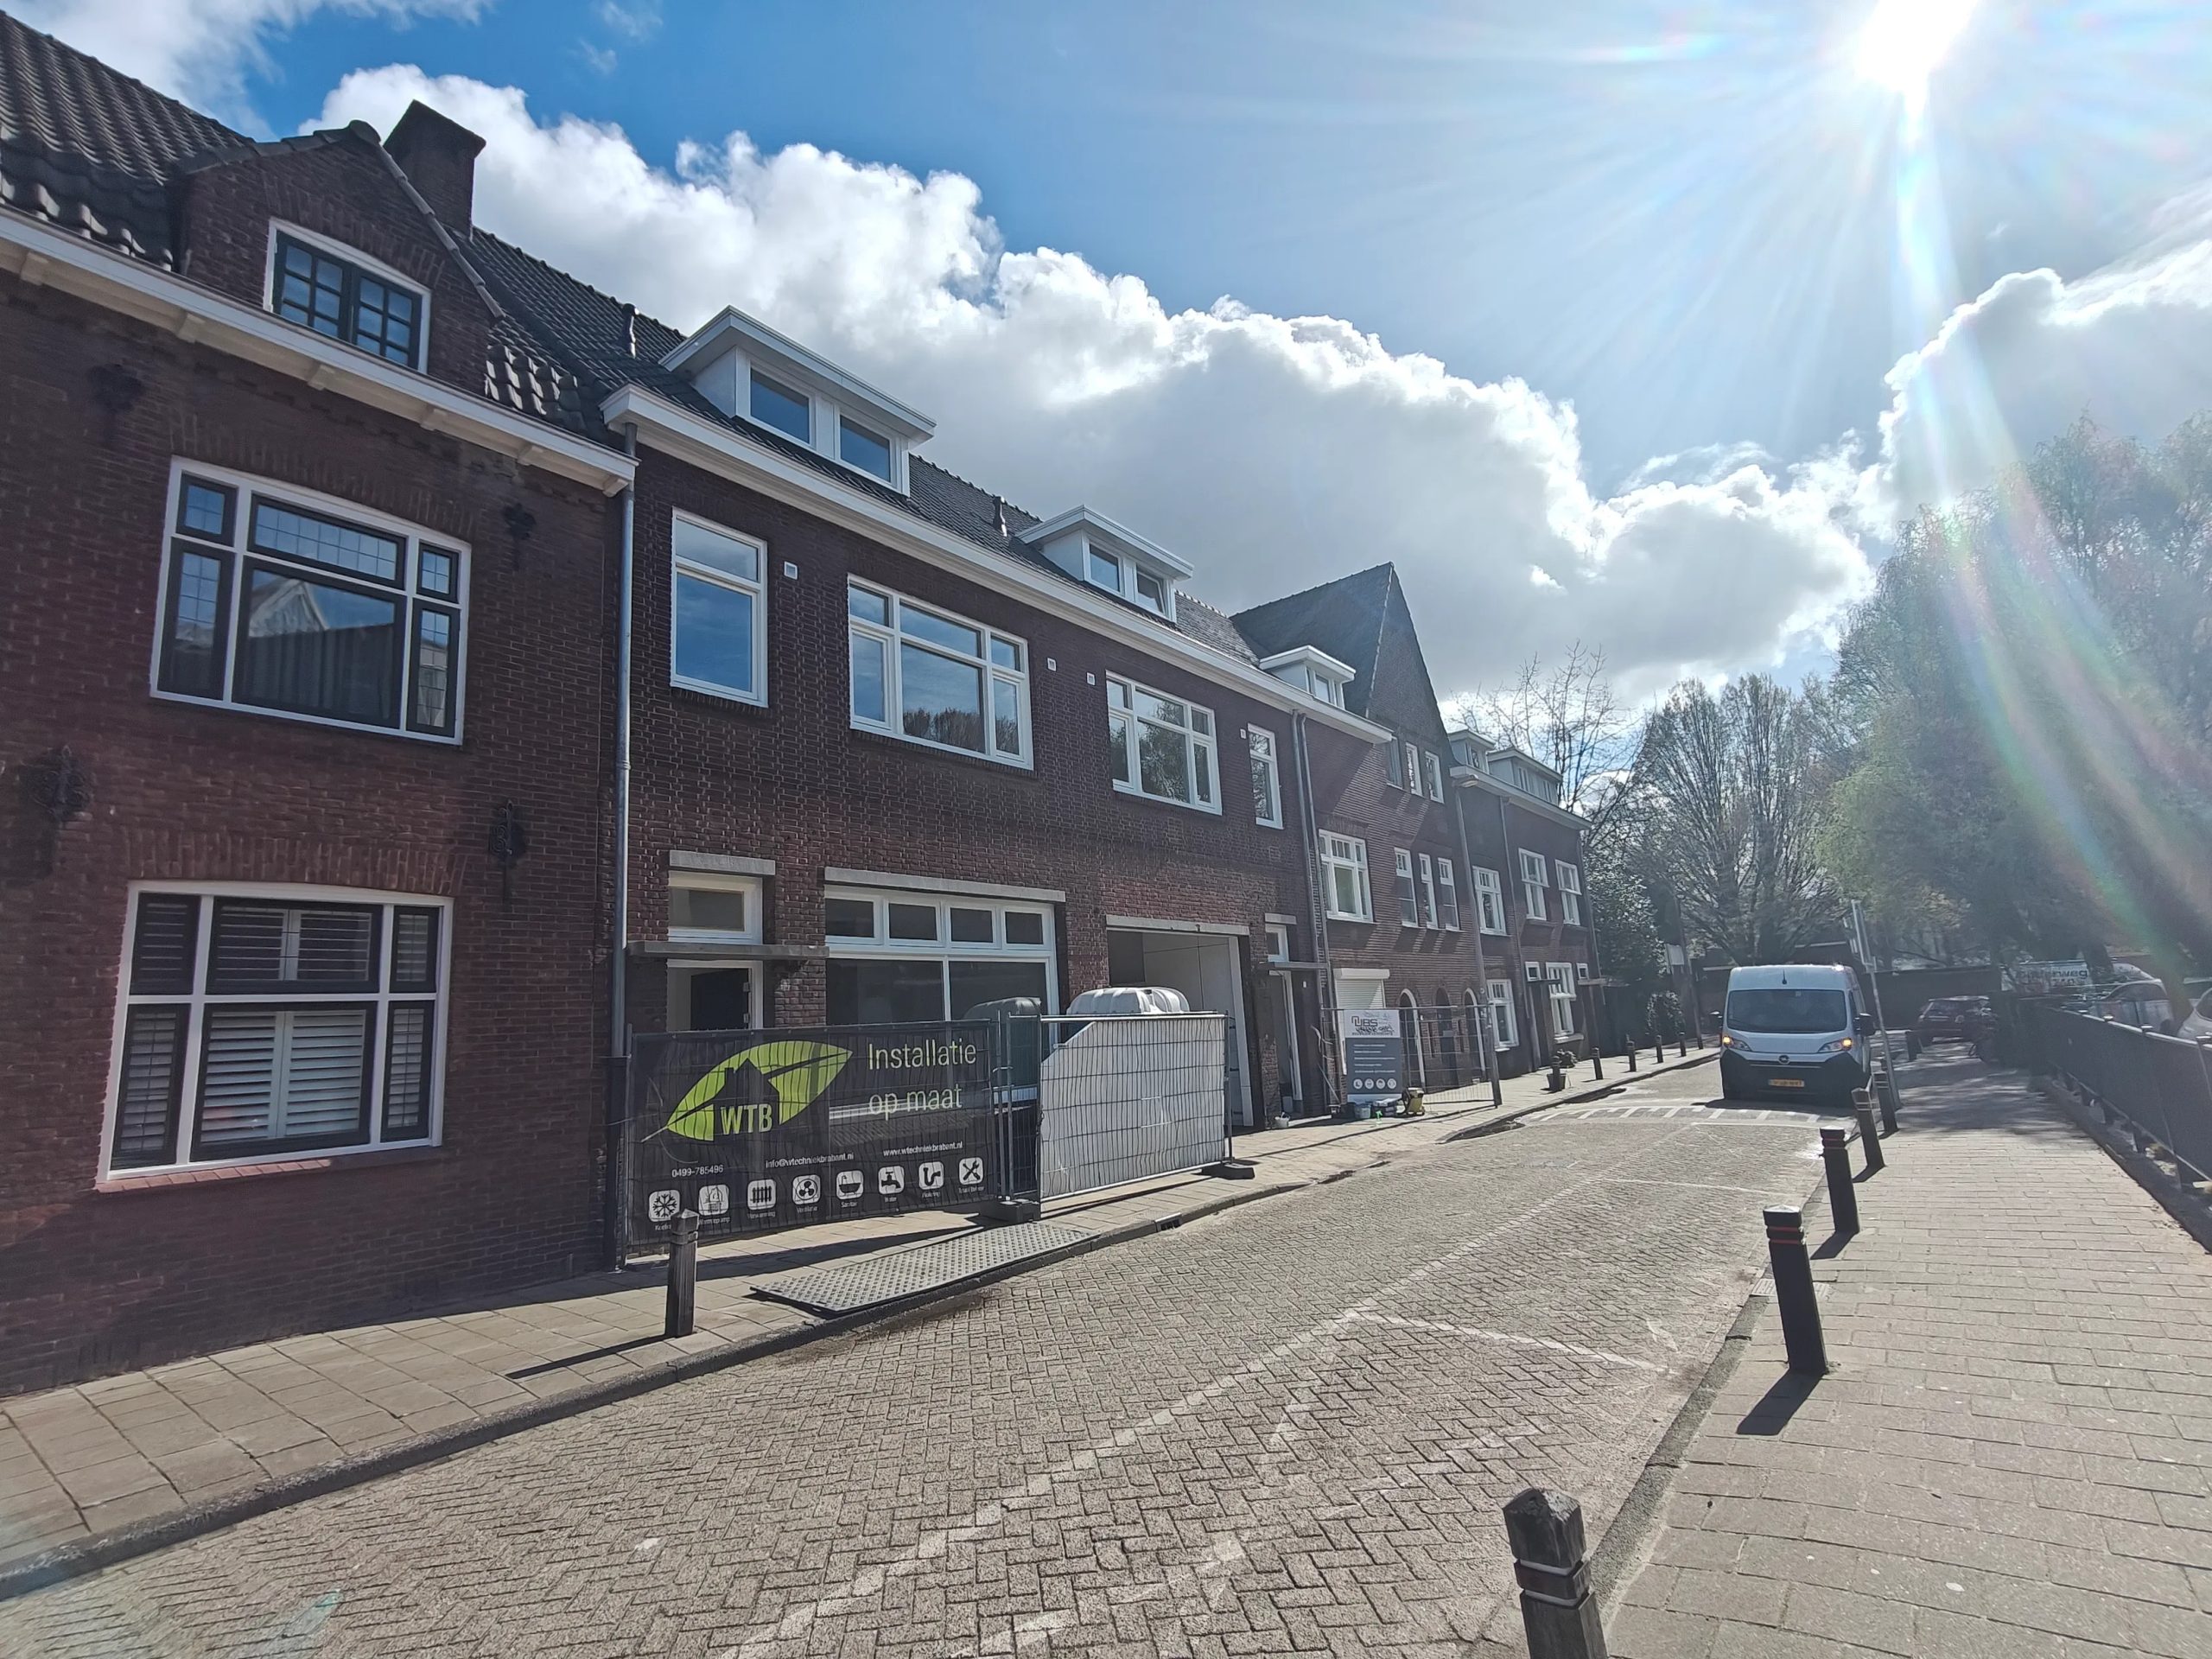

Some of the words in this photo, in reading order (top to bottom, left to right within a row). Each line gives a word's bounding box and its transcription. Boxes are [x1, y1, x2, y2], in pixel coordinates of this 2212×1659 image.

[868, 1038, 977, 1071] Installatie
[868, 1090, 899, 1122] op
[906, 1083, 963, 1112] maat
[720, 1103, 773, 1135] WTB
[671, 1164, 724, 1178] 0499-785496
